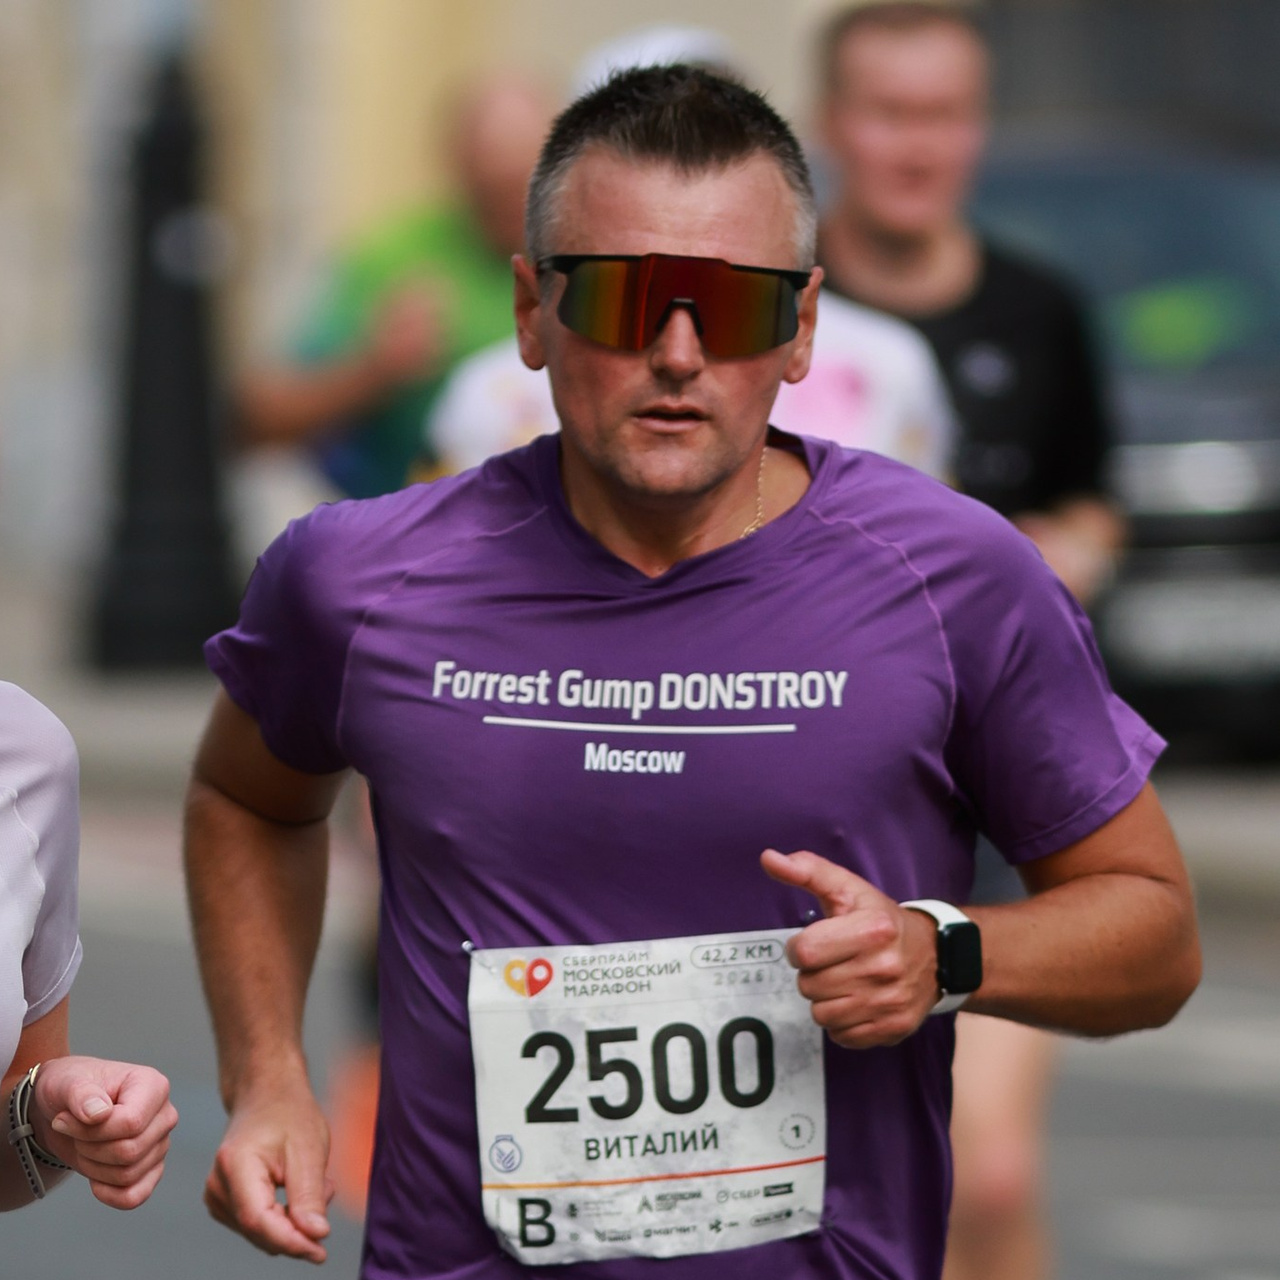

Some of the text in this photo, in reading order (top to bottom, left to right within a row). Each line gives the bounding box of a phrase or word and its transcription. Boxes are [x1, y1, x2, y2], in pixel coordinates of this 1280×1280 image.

[432, 660, 848, 720] Forrest Gump DONSTROY
[583, 742, 686, 774] Moscow
[562, 951, 649, 967] СБЕРПРАЙМ
[701, 947, 738, 964] 42,2
[563, 961, 682, 982] МОСКОВСКИЙ
[563, 980, 652, 998] МАРАФОН
[521, 1016, 776, 1123] 2500
[585, 1123, 719, 1160] ВИТАЛИЙ
[791, 1124, 801, 1139] 1
[518, 1198, 556, 1247] B
